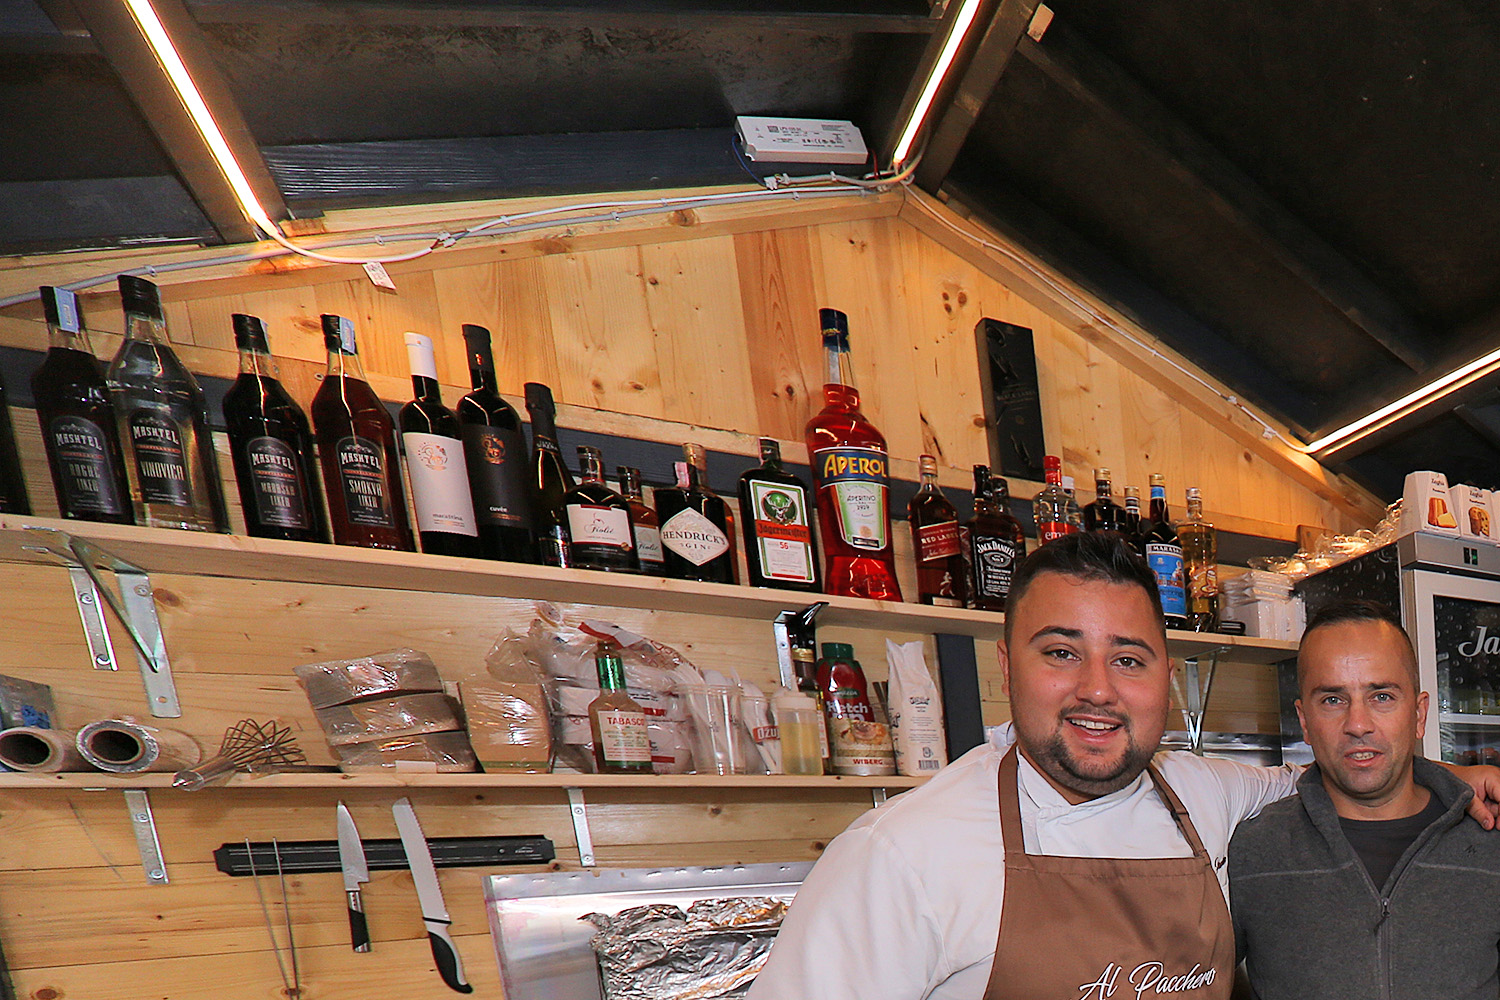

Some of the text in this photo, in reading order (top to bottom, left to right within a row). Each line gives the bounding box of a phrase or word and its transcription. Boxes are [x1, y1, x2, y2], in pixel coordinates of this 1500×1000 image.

[56, 433, 102, 450] MASHTEL
[133, 425, 179, 445] MASHTEL
[252, 453, 294, 471] MASHTEL
[340, 452, 382, 470] MASHTEL
[824, 454, 888, 479] APEROL
[349, 479, 383, 497] SMOKVA
[685, 542, 709, 550] GIN
[921, 536, 937, 544] RED
[976, 541, 992, 553] JACK
[607, 716, 645, 726] TABASCO
